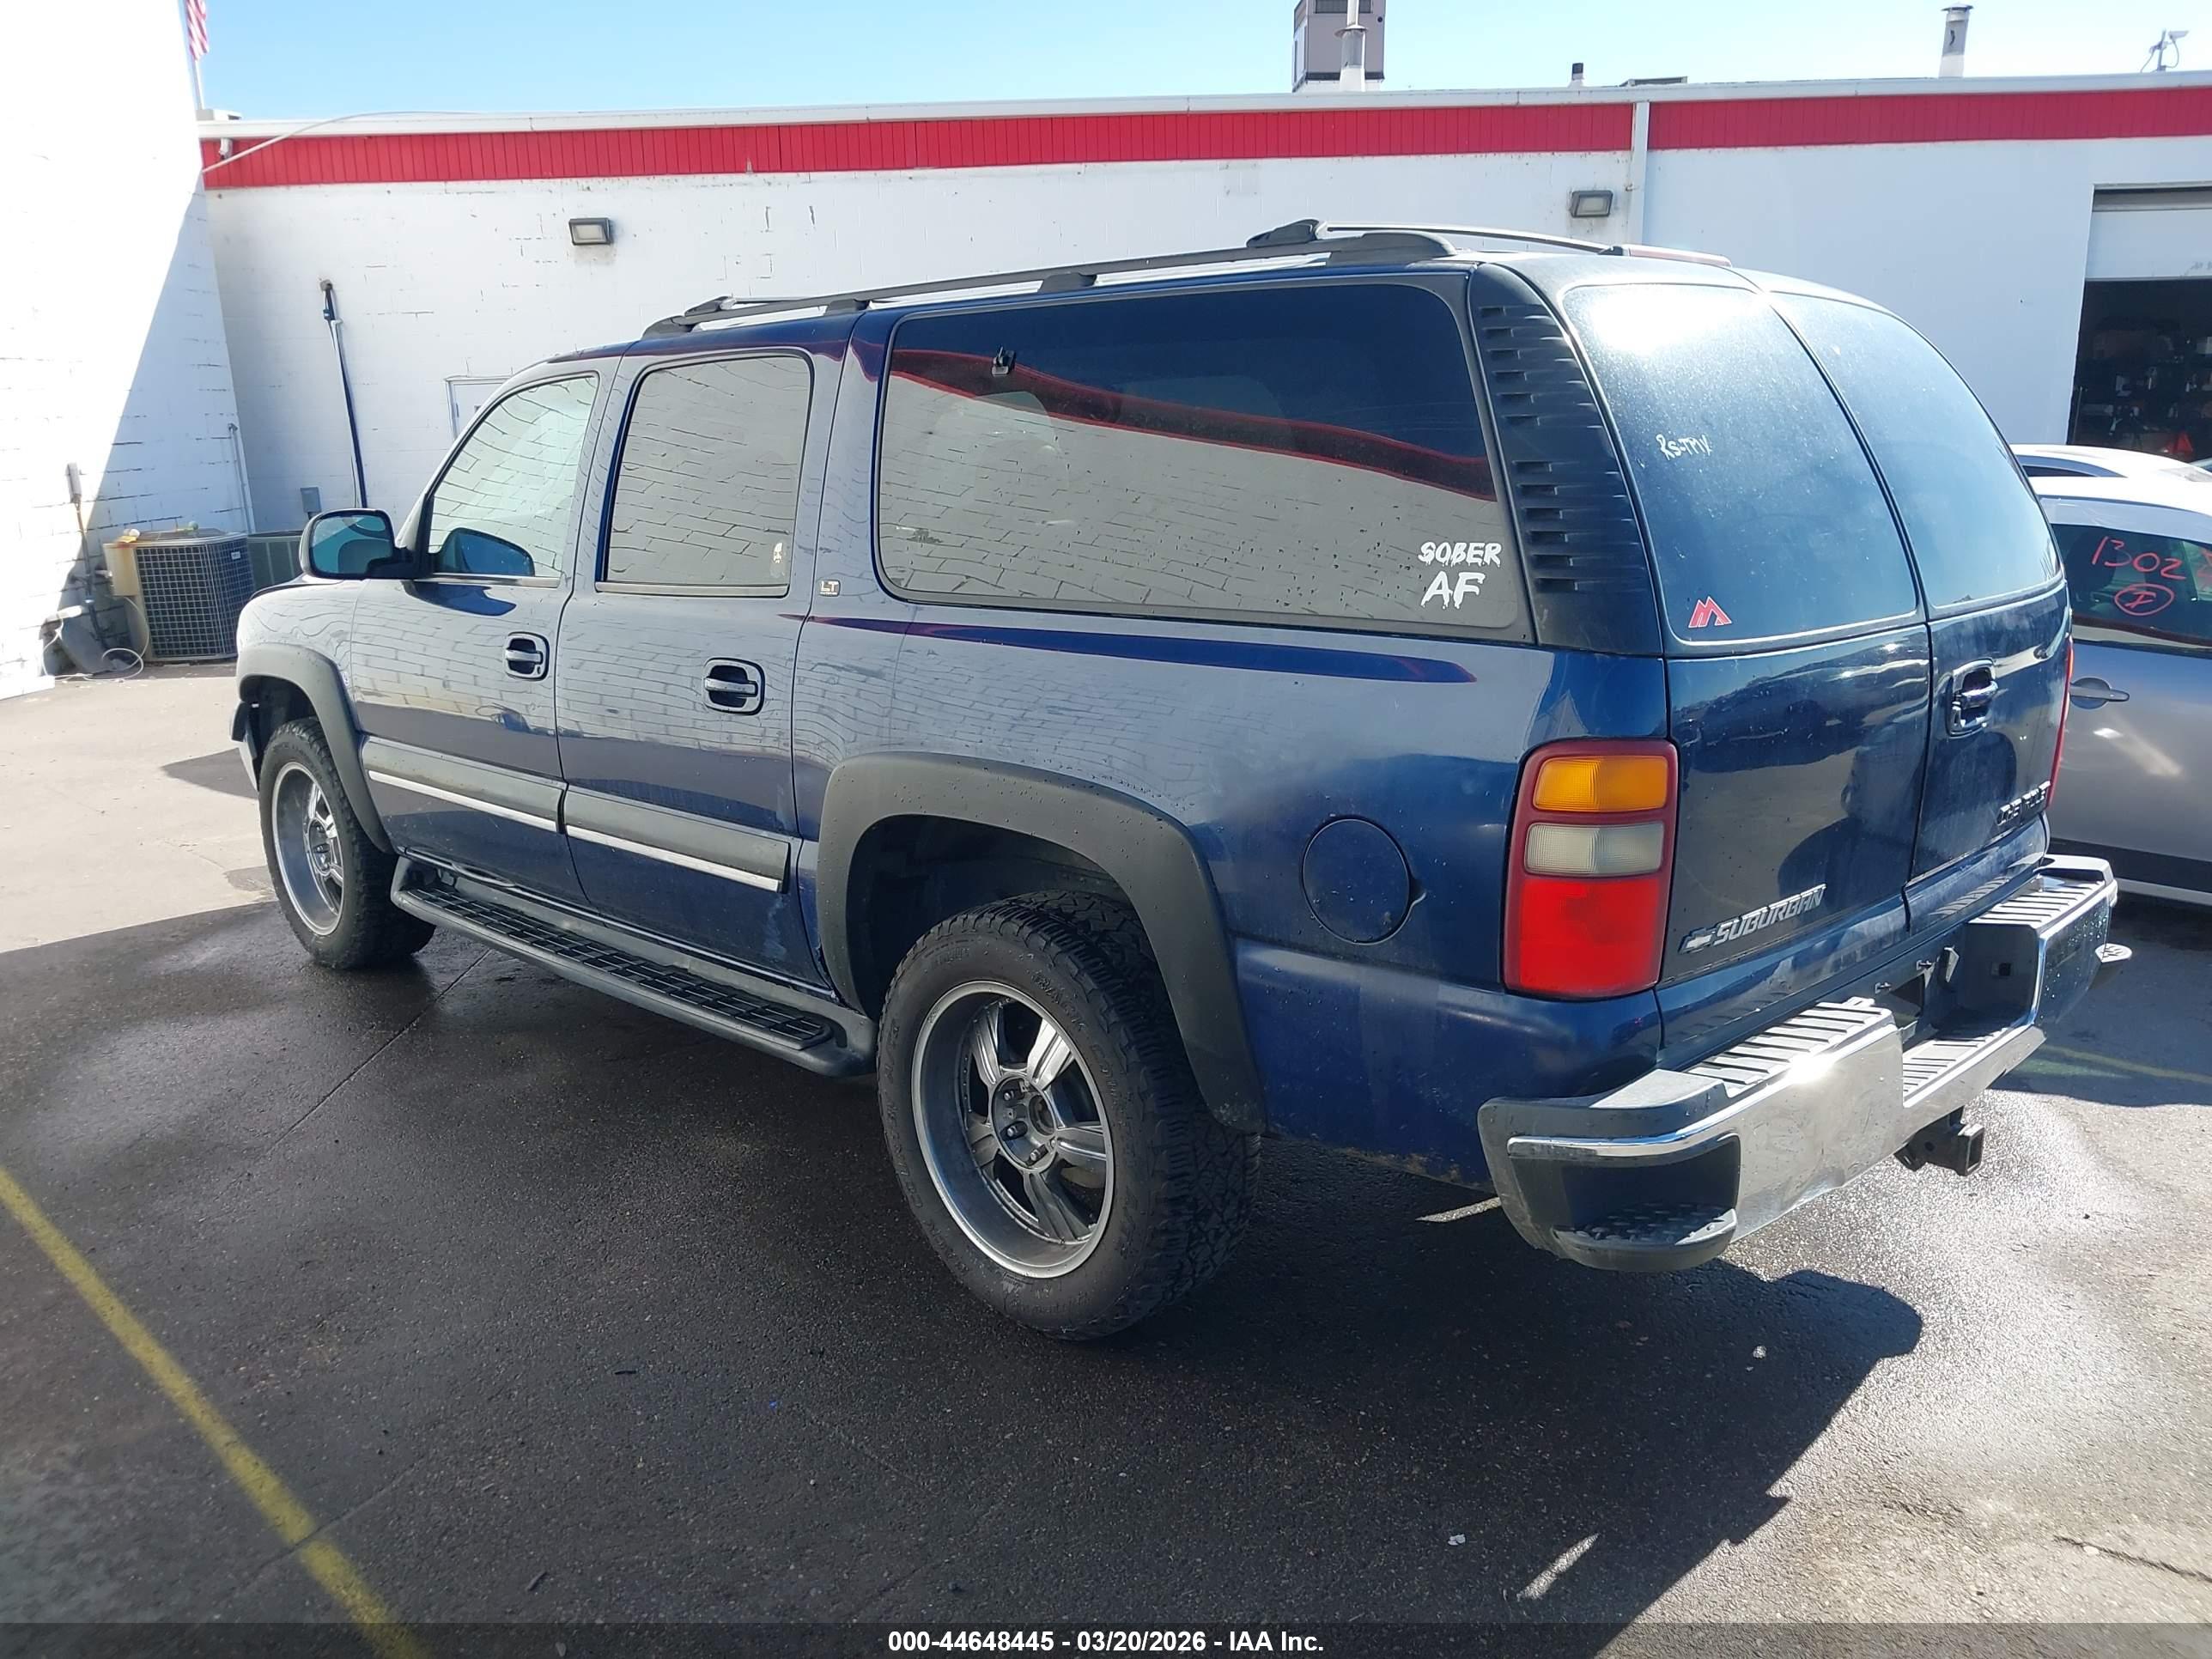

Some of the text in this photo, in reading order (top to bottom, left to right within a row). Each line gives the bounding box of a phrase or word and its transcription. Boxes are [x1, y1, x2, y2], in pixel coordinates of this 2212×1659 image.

[1418, 541, 1503, 568] SOBER
[2091, 536, 2187, 580] 1302
[819, 580, 840, 593] LT
[1419, 570, 1486, 610] AF
[1713, 883, 1826, 946] SUBURBAN
